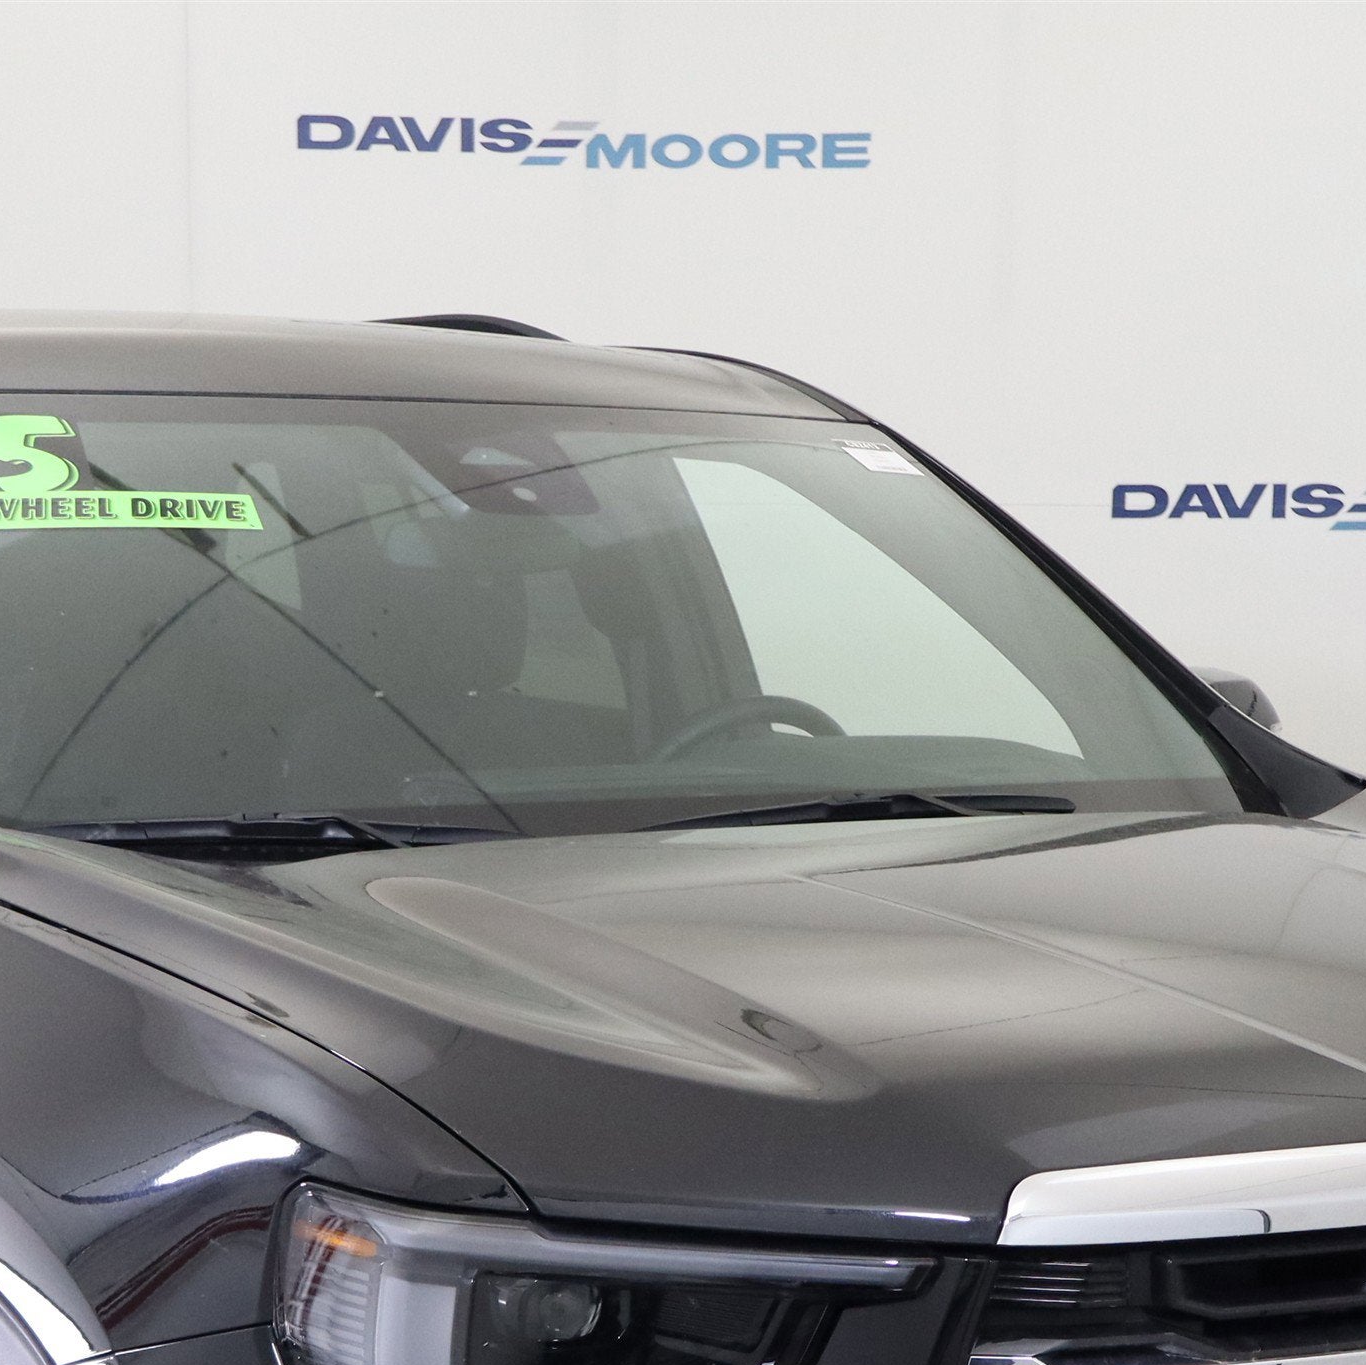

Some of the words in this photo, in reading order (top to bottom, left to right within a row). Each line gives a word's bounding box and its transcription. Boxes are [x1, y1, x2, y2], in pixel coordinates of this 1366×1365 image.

[296, 114, 533, 154] DAVIS
[585, 132, 871, 170] MOORE
[129, 497, 248, 521] DRIVE
[1110, 483, 1346, 519] DAVIS
